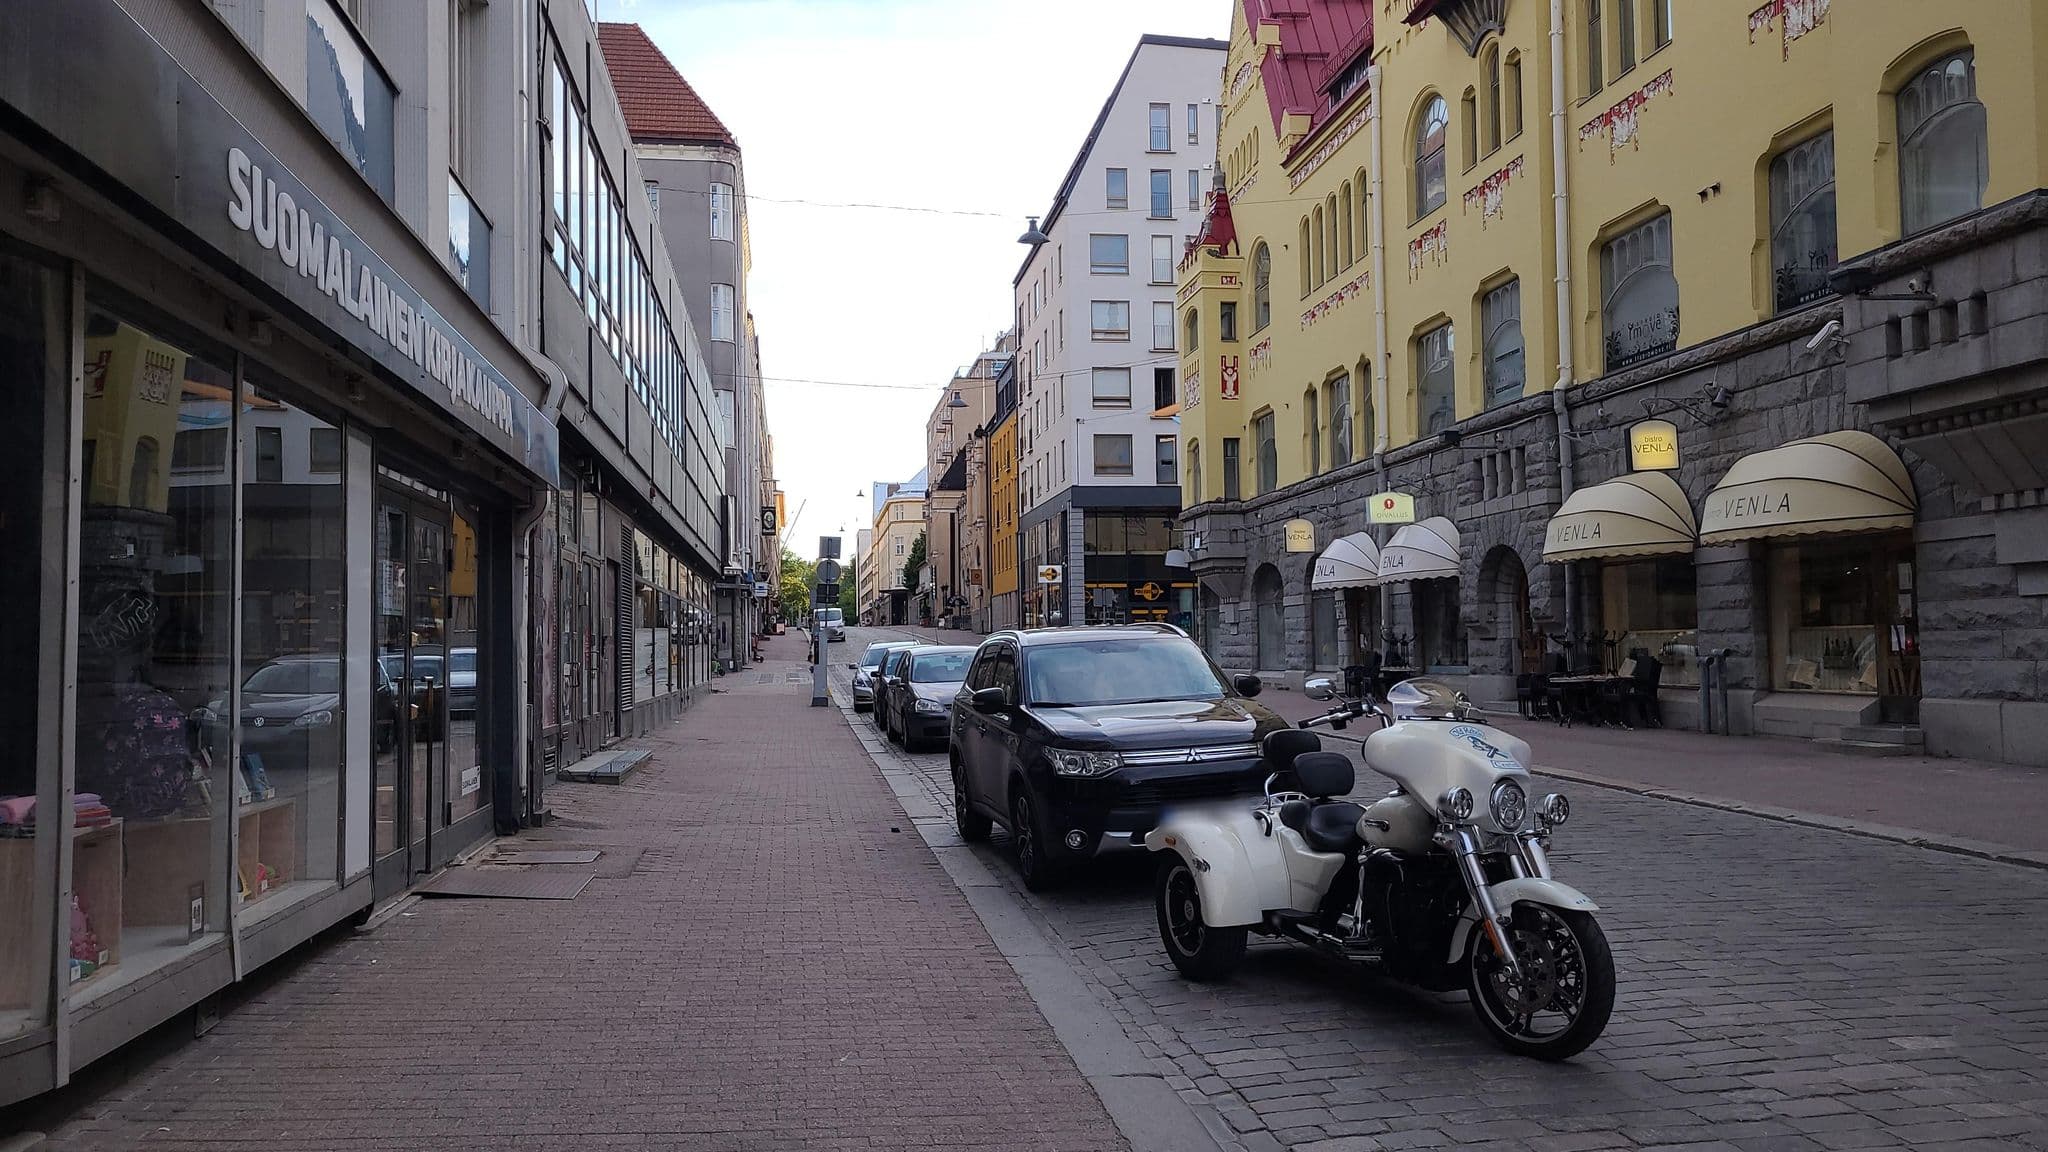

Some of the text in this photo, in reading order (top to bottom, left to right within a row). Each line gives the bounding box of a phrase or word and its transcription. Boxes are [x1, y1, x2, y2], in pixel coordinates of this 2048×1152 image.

[228, 148, 424, 366] SUOMALAINEN
[1634, 443, 1674, 454] VENLA
[1725, 492, 1790, 518] VENLA
[1557, 522, 1601, 543] VENLA
[1383, 555, 1404, 568] ENLA
